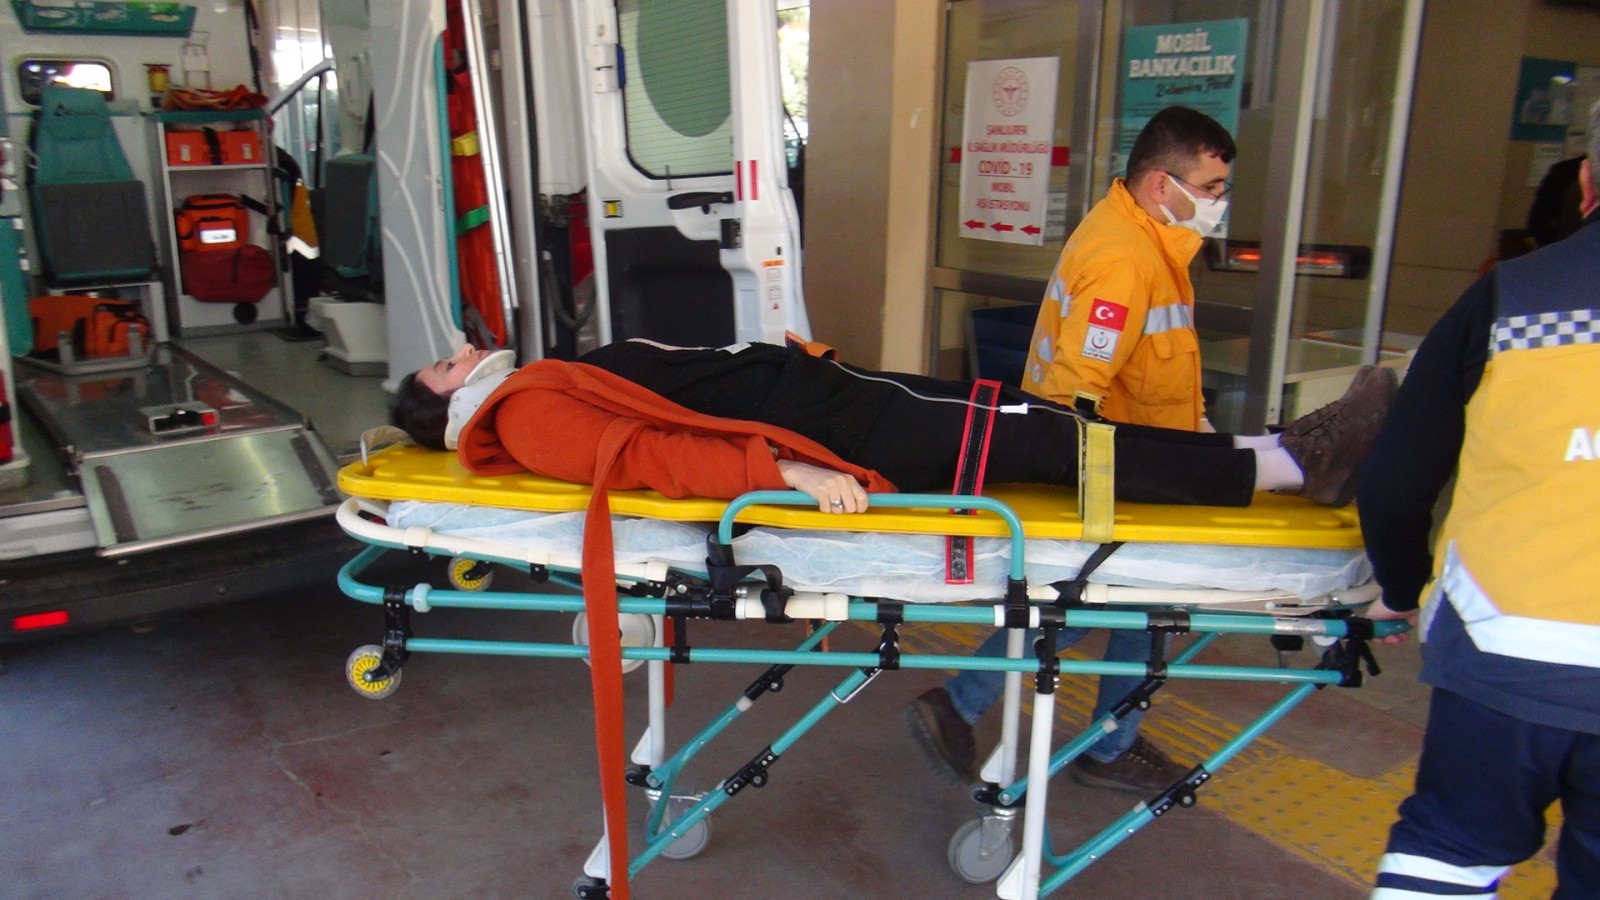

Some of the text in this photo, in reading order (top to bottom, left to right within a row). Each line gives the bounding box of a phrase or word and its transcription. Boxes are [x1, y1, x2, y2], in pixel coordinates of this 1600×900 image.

[1155, 28, 1211, 54] MOBİL
[1128, 55, 1236, 78] BANKACILIK
[1019, 162, 1034, 175] 19
